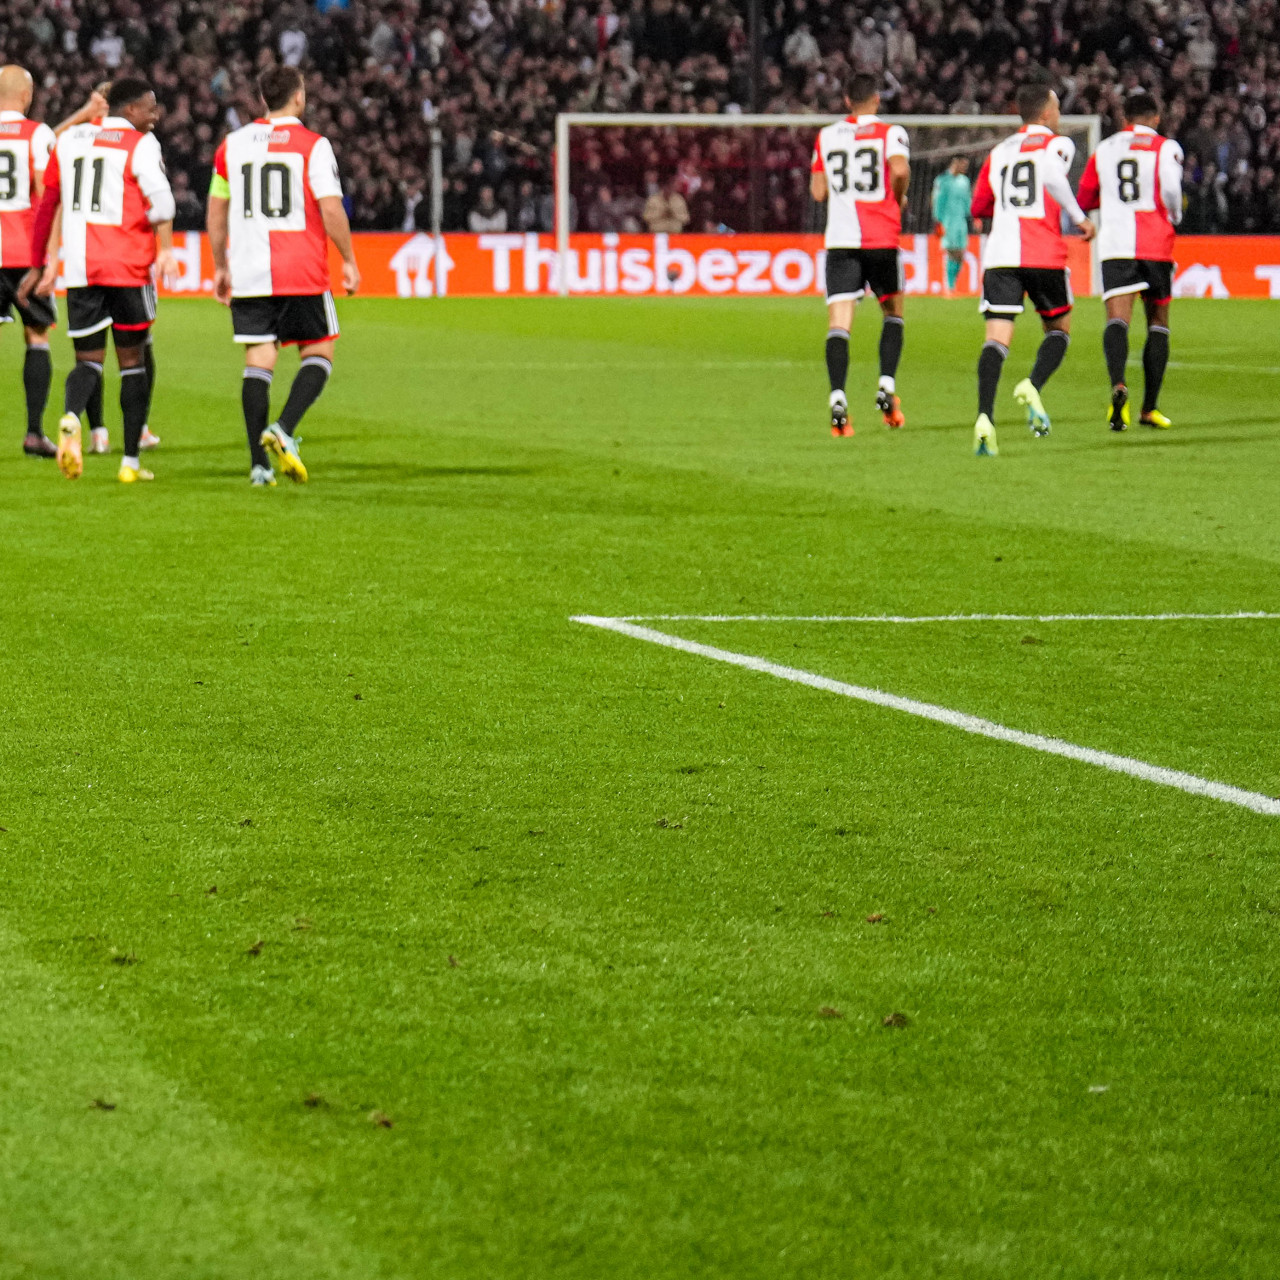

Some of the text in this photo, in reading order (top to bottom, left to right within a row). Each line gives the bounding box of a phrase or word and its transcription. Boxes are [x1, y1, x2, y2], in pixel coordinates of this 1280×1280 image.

[72, 156, 105, 213] 11
[242, 162, 292, 219] 10
[827, 148, 879, 193] 33
[1000, 160, 1037, 208] 19
[1117, 158, 1140, 202] 8
